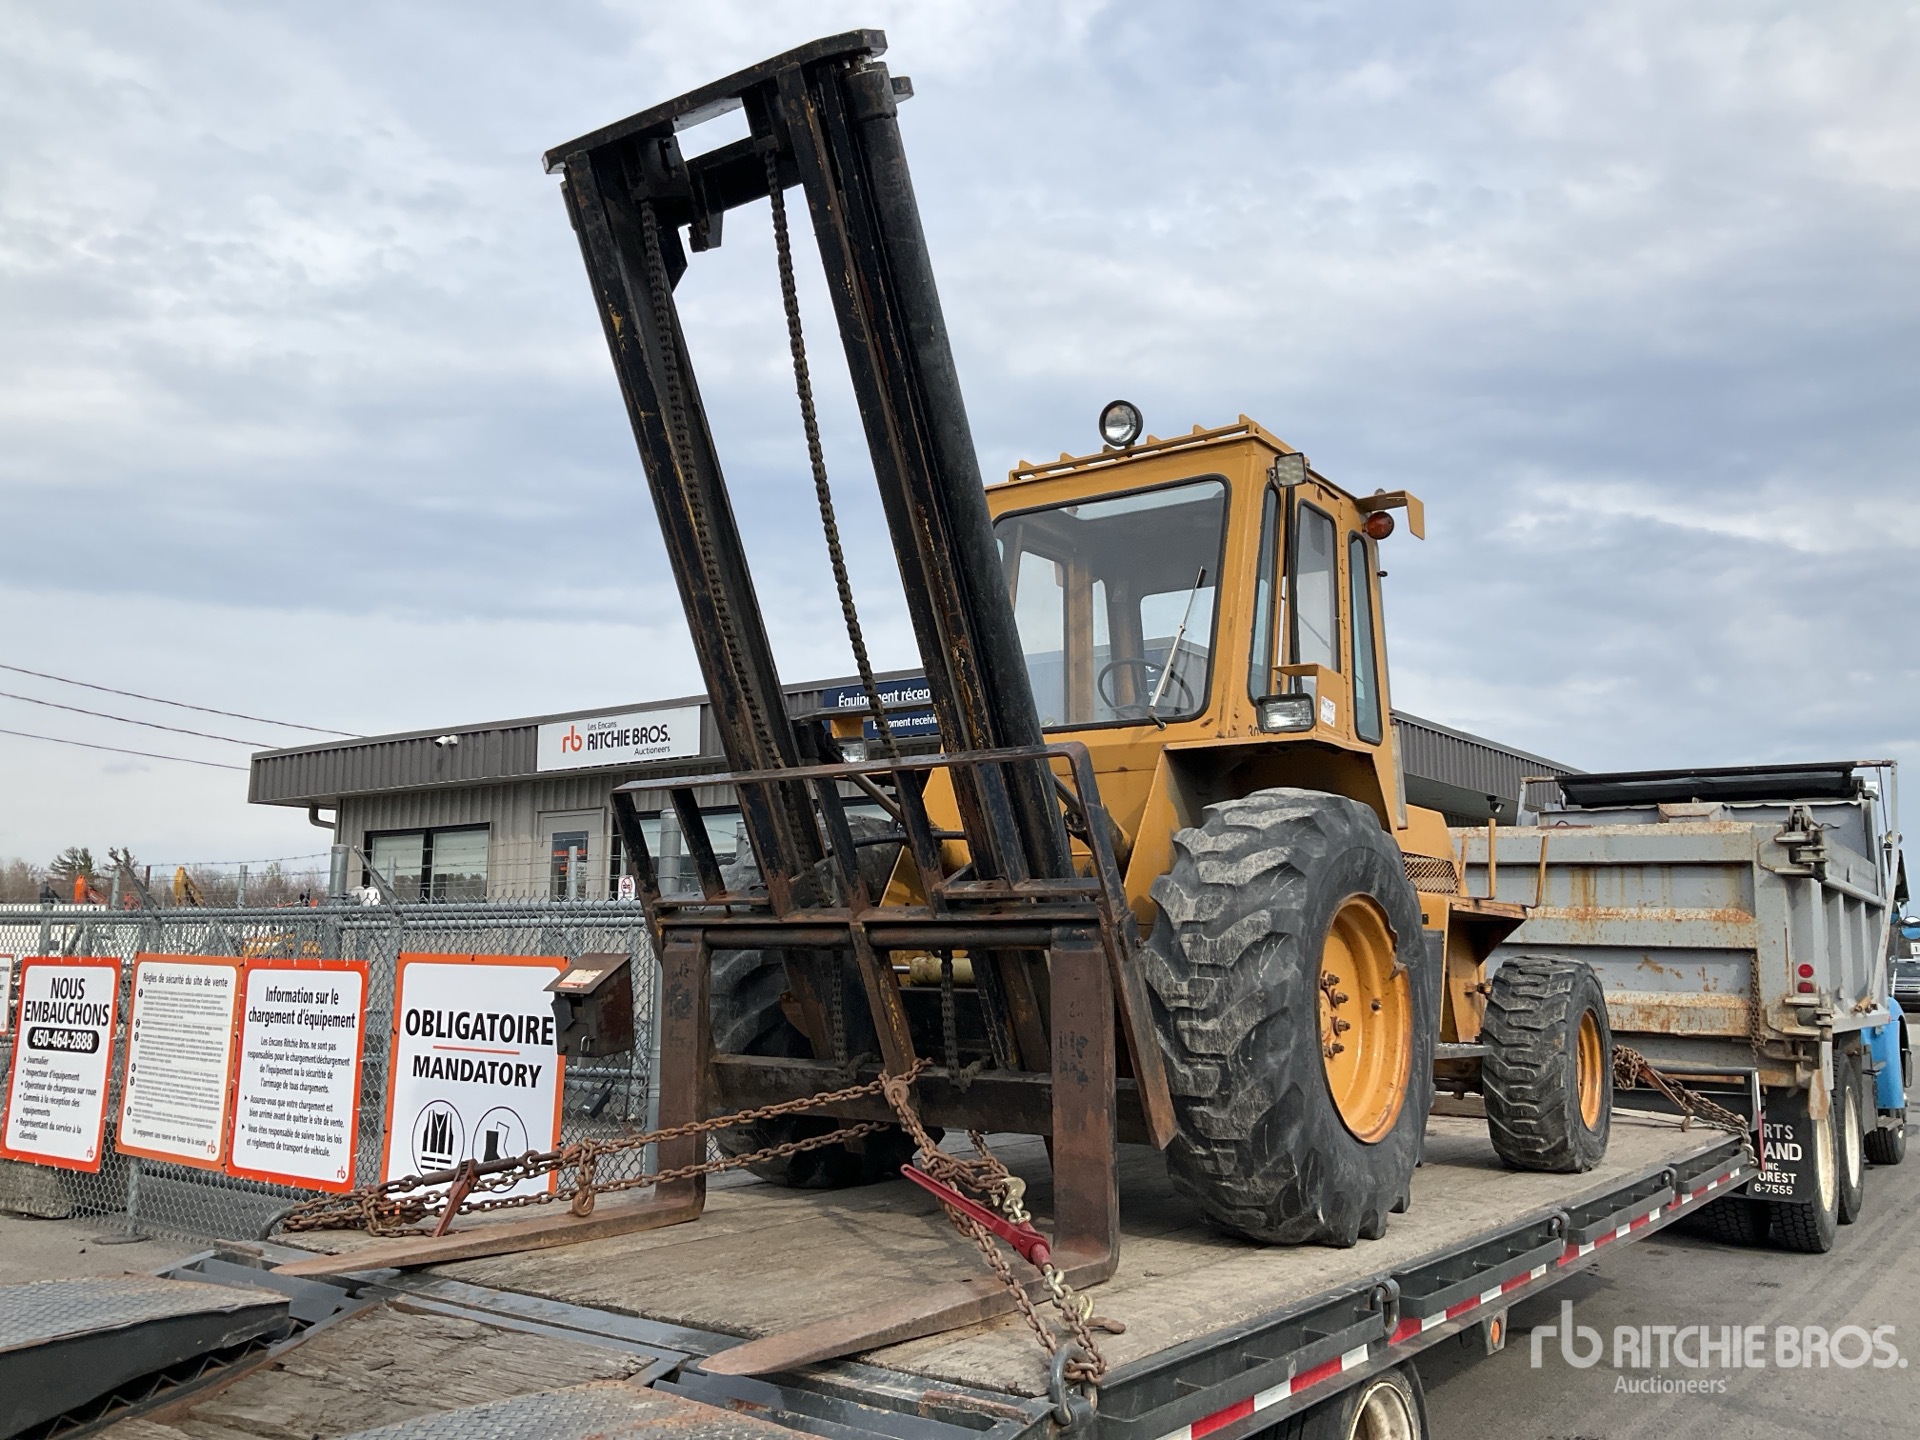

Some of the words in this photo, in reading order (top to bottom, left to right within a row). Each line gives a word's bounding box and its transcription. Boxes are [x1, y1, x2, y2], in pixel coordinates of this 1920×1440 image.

[838, 692, 899, 707] Équipent
[588, 723, 597, 731] Les
[598, 721, 617, 730] Encans
[562, 725, 583, 753] rb
[587, 728, 631, 751] RITCHIE
[632, 724, 671, 746] BROS.
[634, 746, 671, 756] Auctioneers
[143, 972, 158, 985] Règles
[158, 973, 165, 984] de
[165, 974, 185, 985] sécurité
[185, 974, 192, 985] du
[193, 975, 203, 986] site
[204, 975, 211, 987] de
[212, 977, 229, 988] vente
[50, 977, 85, 1000] NOUS
[265, 985, 313, 1004] Information
[315, 991, 329, 1005] sur
[331, 988, 339, 1005] le
[24, 1000, 110, 1027] EMBAUCHONS
[248, 1006, 295, 1027] chargement
[297, 1009, 356, 1031] d'équipement
[405, 1008, 554, 1046] OBLIGATOIRE
[32, 1029, 94, 1051] 450-464-2888
[260, 1036, 268, 1046] Les
[268, 1037, 283, 1047] Encans
[284, 1038, 299, 1048] Ritchie
[311, 1042, 317, 1050] ne
[317, 1041, 328, 1051] sont
[328, 1043, 337, 1053] pas
[247, 1050, 274, 1061] responsables
[274, 1053, 285, 1062] pour
[25, 1068, 48, 1078] Inspecteur
[259, 1064, 266, 1073] de
[327, 1070, 333, 1080] de
[412, 1054, 542, 1089] MANDATORY
[46, 1083, 53, 1091] de
[53, 1084, 77, 1095] chargeuse
[282, 1080, 289, 1090] de
[289, 1081, 299, 1091] tous
[23, 1093, 40, 1102] Commis
[71, 1098, 80, 1107] des
[277, 1099, 286, 1109] que
[286, 1100, 298, 1109] votre
[298, 1100, 326, 1112] chargement
[326, 1104, 334, 1112] est
[248, 1108, 258, 1117] bien
[273, 1112, 286, 1121] avant
[286, 1112, 292, 1122] de
[292, 1113, 309, 1125] quitter
[314, 1115, 323, 1126] site
[323, 1116, 329, 1126] de
[49, 1121, 55, 1130] du
[55, 1123, 72, 1133] service
[76, 1125, 82, 1134] la
[1763, 1123, 1794, 1140] RTS
[268, 1127, 294, 1138] responsable
[294, 1129, 301, 1139] de
[301, 1130, 315, 1141] suivre
[315, 1132, 326, 1142] tous
[333, 1134, 343, 1145] lois
[207, 1140, 217, 1154] rb
[275, 1141, 282, 1151] de
[282, 1143, 304, 1155] transport
[304, 1144, 310, 1155] de
[1763, 1141, 1803, 1161] AND
[337, 1166, 347, 1179] rb
[1765, 1162, 1781, 1171] INC.
[1757, 1171, 1797, 1184] OREST
[1754, 1183, 1793, 1195] 6-7555
